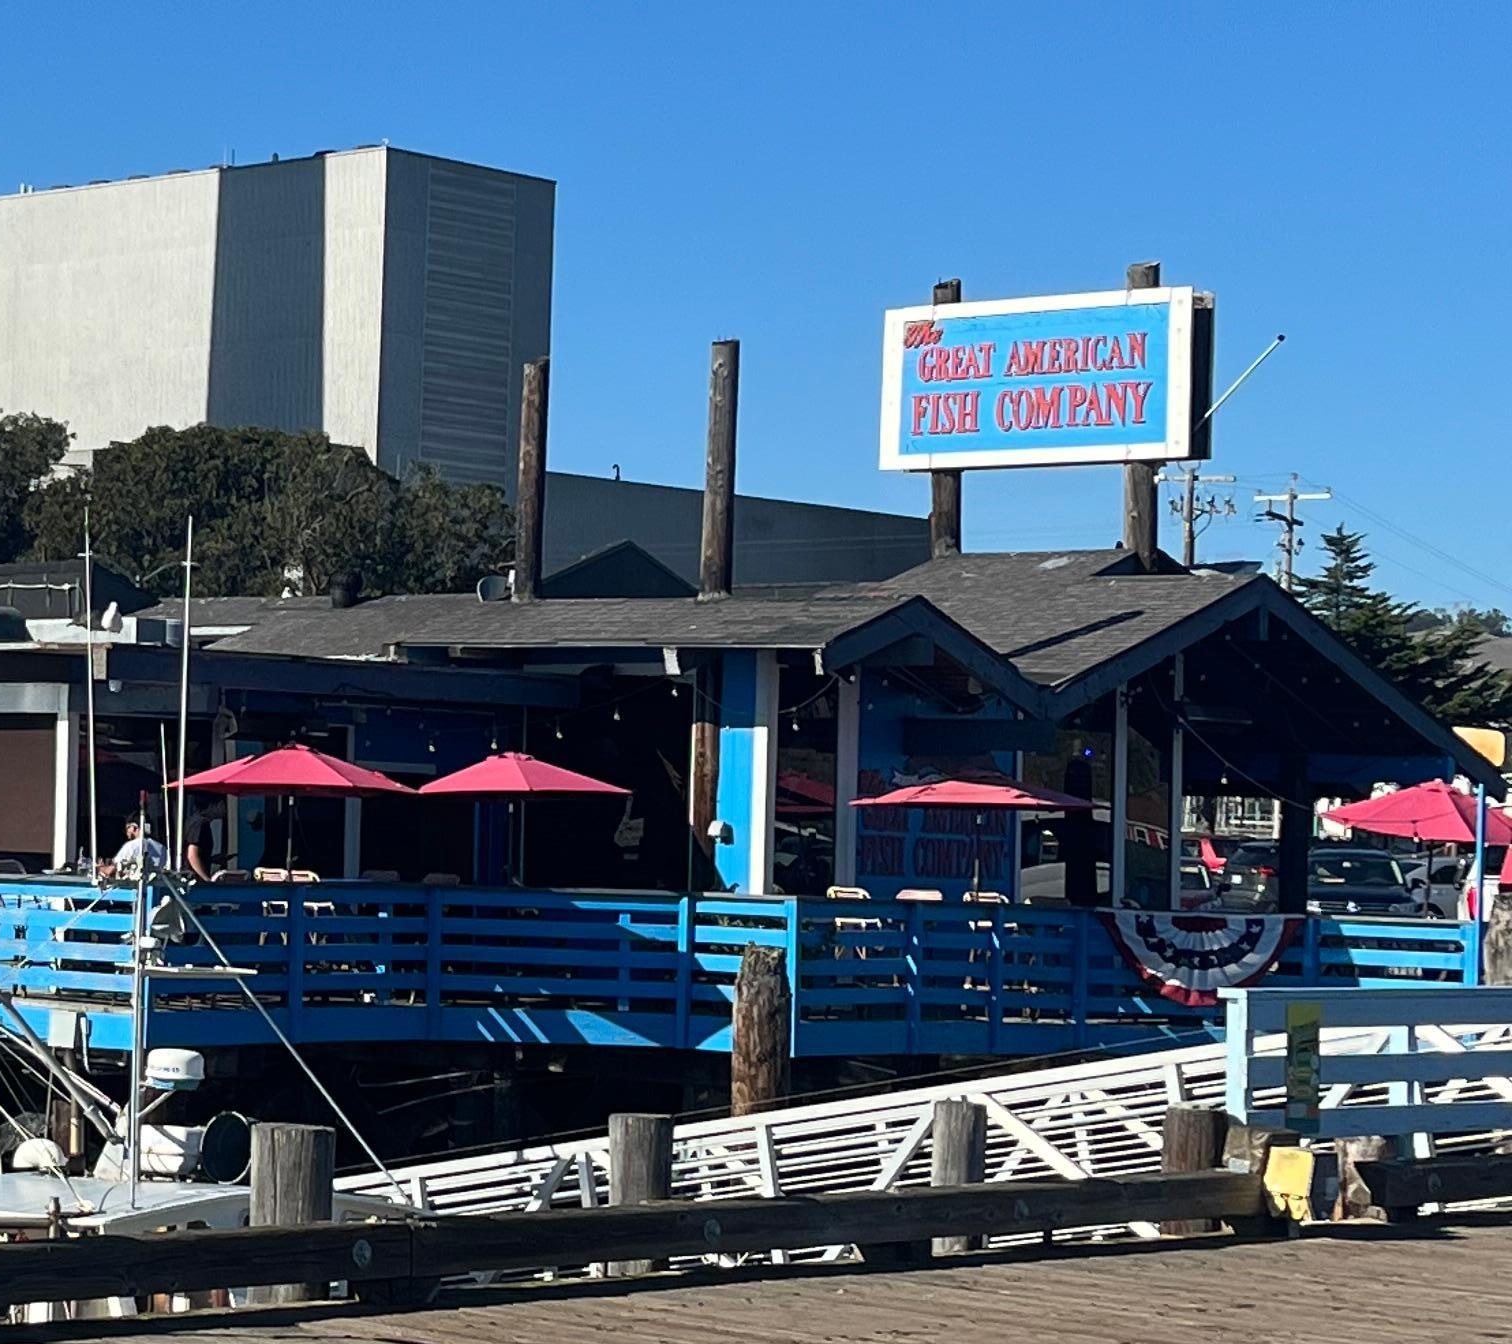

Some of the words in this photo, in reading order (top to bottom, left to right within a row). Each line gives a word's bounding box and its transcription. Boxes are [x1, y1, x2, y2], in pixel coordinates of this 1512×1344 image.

[904, 320, 943, 348] The
[918, 343, 996, 382] GREAT
[1003, 332, 1148, 377] AMERICAN
[911, 391, 981, 436] FISH
[996, 382, 1153, 432] COMPANY
